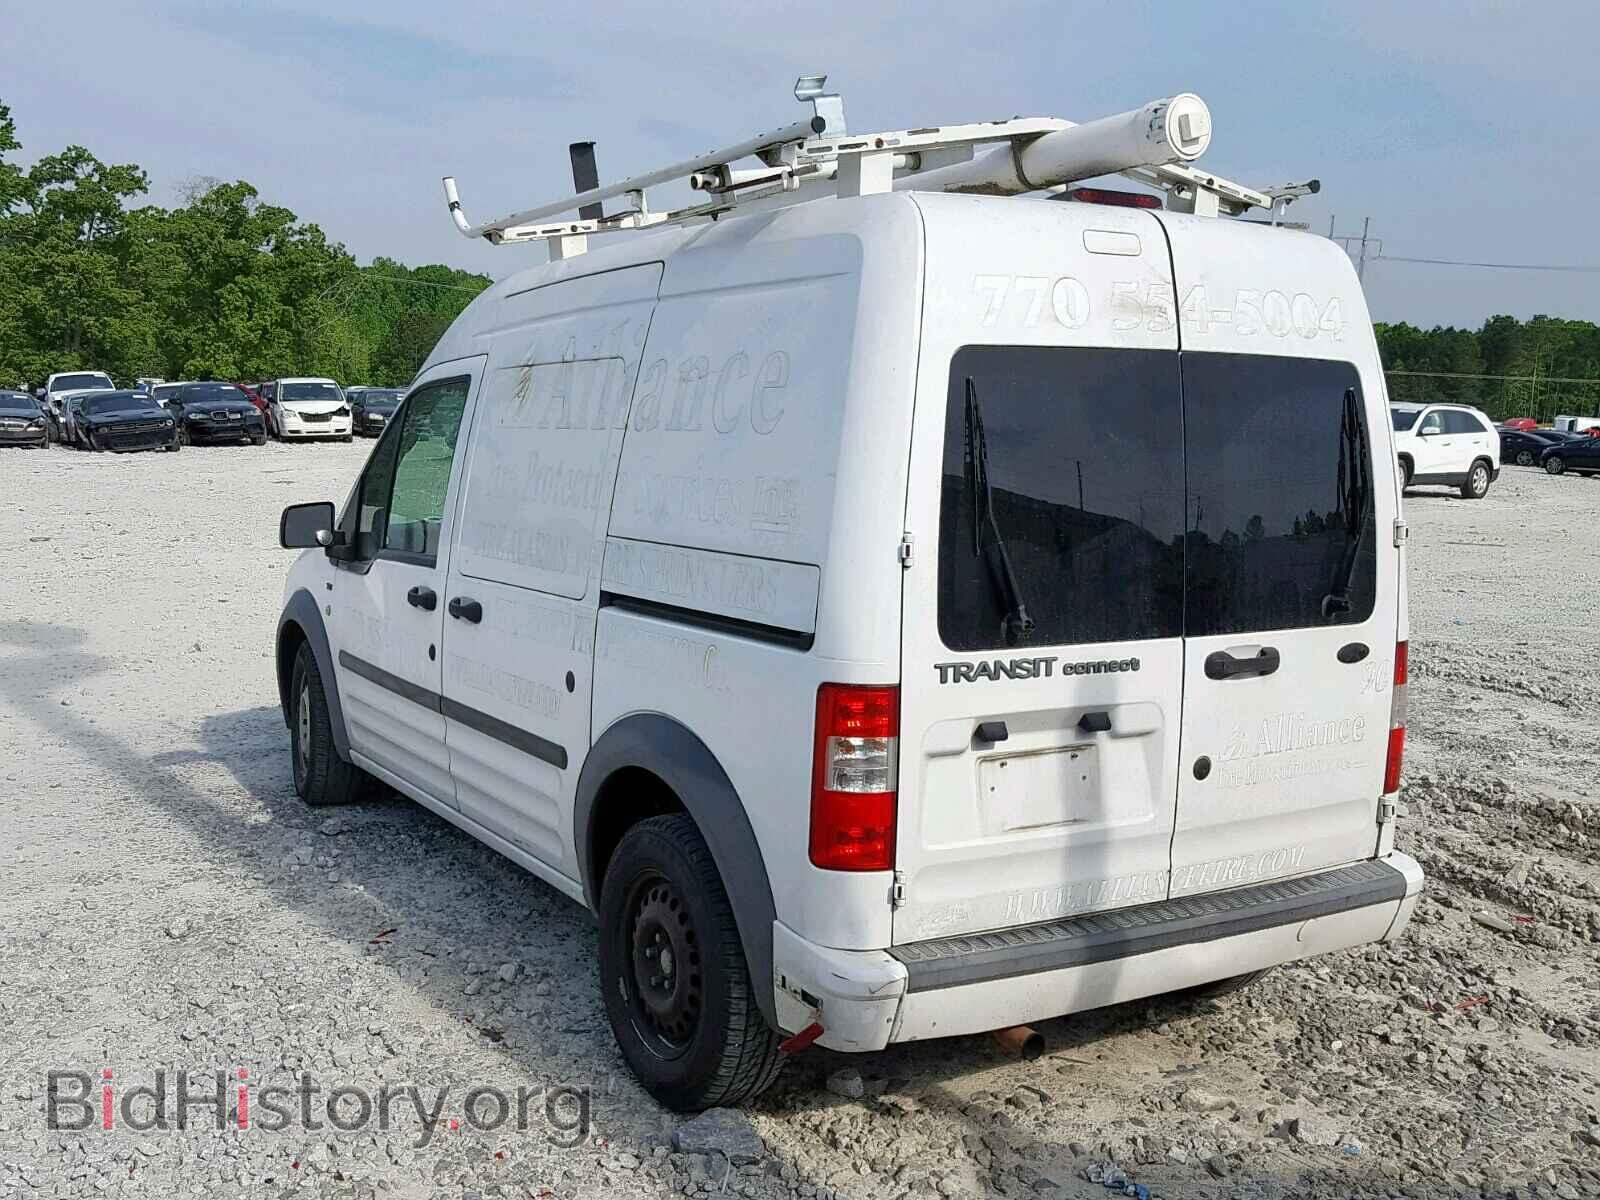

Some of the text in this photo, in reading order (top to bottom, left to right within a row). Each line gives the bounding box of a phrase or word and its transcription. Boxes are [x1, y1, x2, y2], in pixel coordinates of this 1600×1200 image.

[973, 275, 1349, 343] 770 554-5004
[934, 657, 1140, 684] TRANSIT connect
[1256, 711, 1366, 756] Alliance
